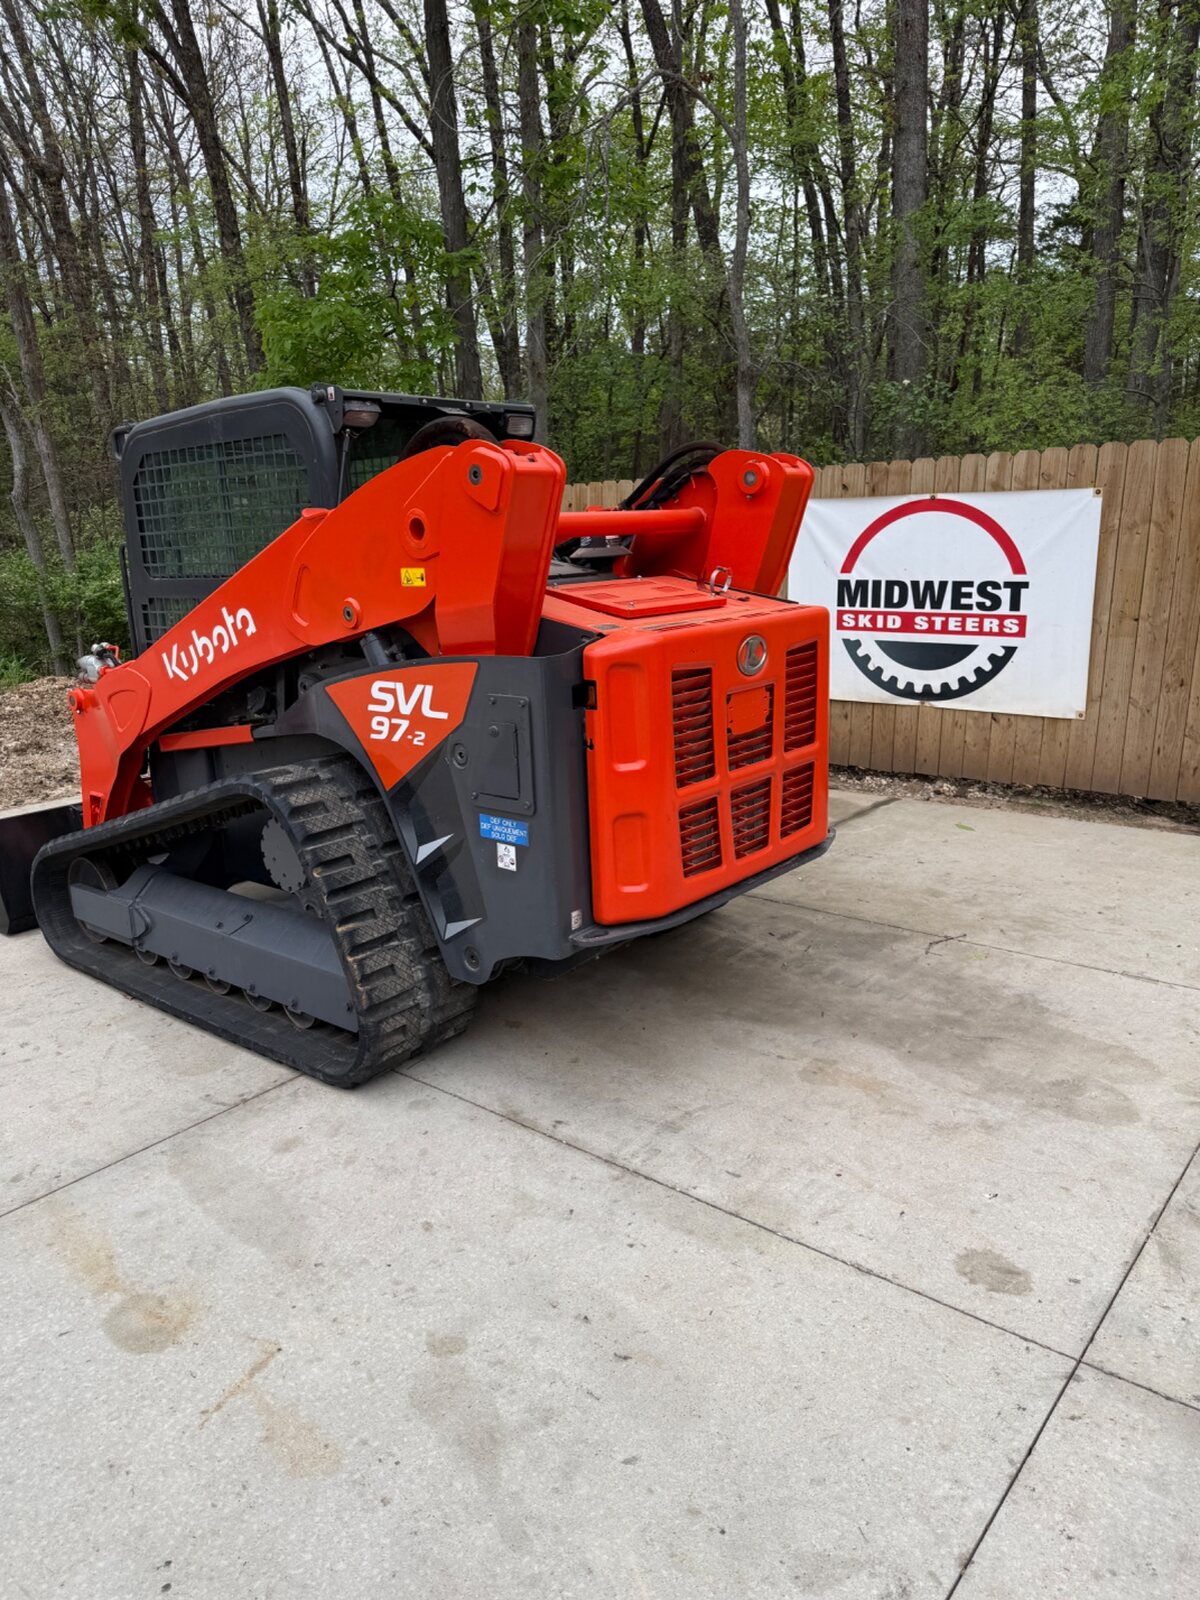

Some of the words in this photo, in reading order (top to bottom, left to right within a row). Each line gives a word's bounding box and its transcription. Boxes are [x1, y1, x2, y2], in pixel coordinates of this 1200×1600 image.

[837, 579, 1030, 612] MIDWEST
[841, 613, 903, 630] SKID
[914, 614, 1020, 634] STEERS
[161, 606, 257, 682] Kubota
[367, 680, 449, 720] SVL
[369, 716, 425, 746] 97-2
[481, 822, 492, 830] DEF
[489, 816, 501, 824] DEF
[501, 819, 517, 828] ONLY
[506, 834, 517, 842] DEF
